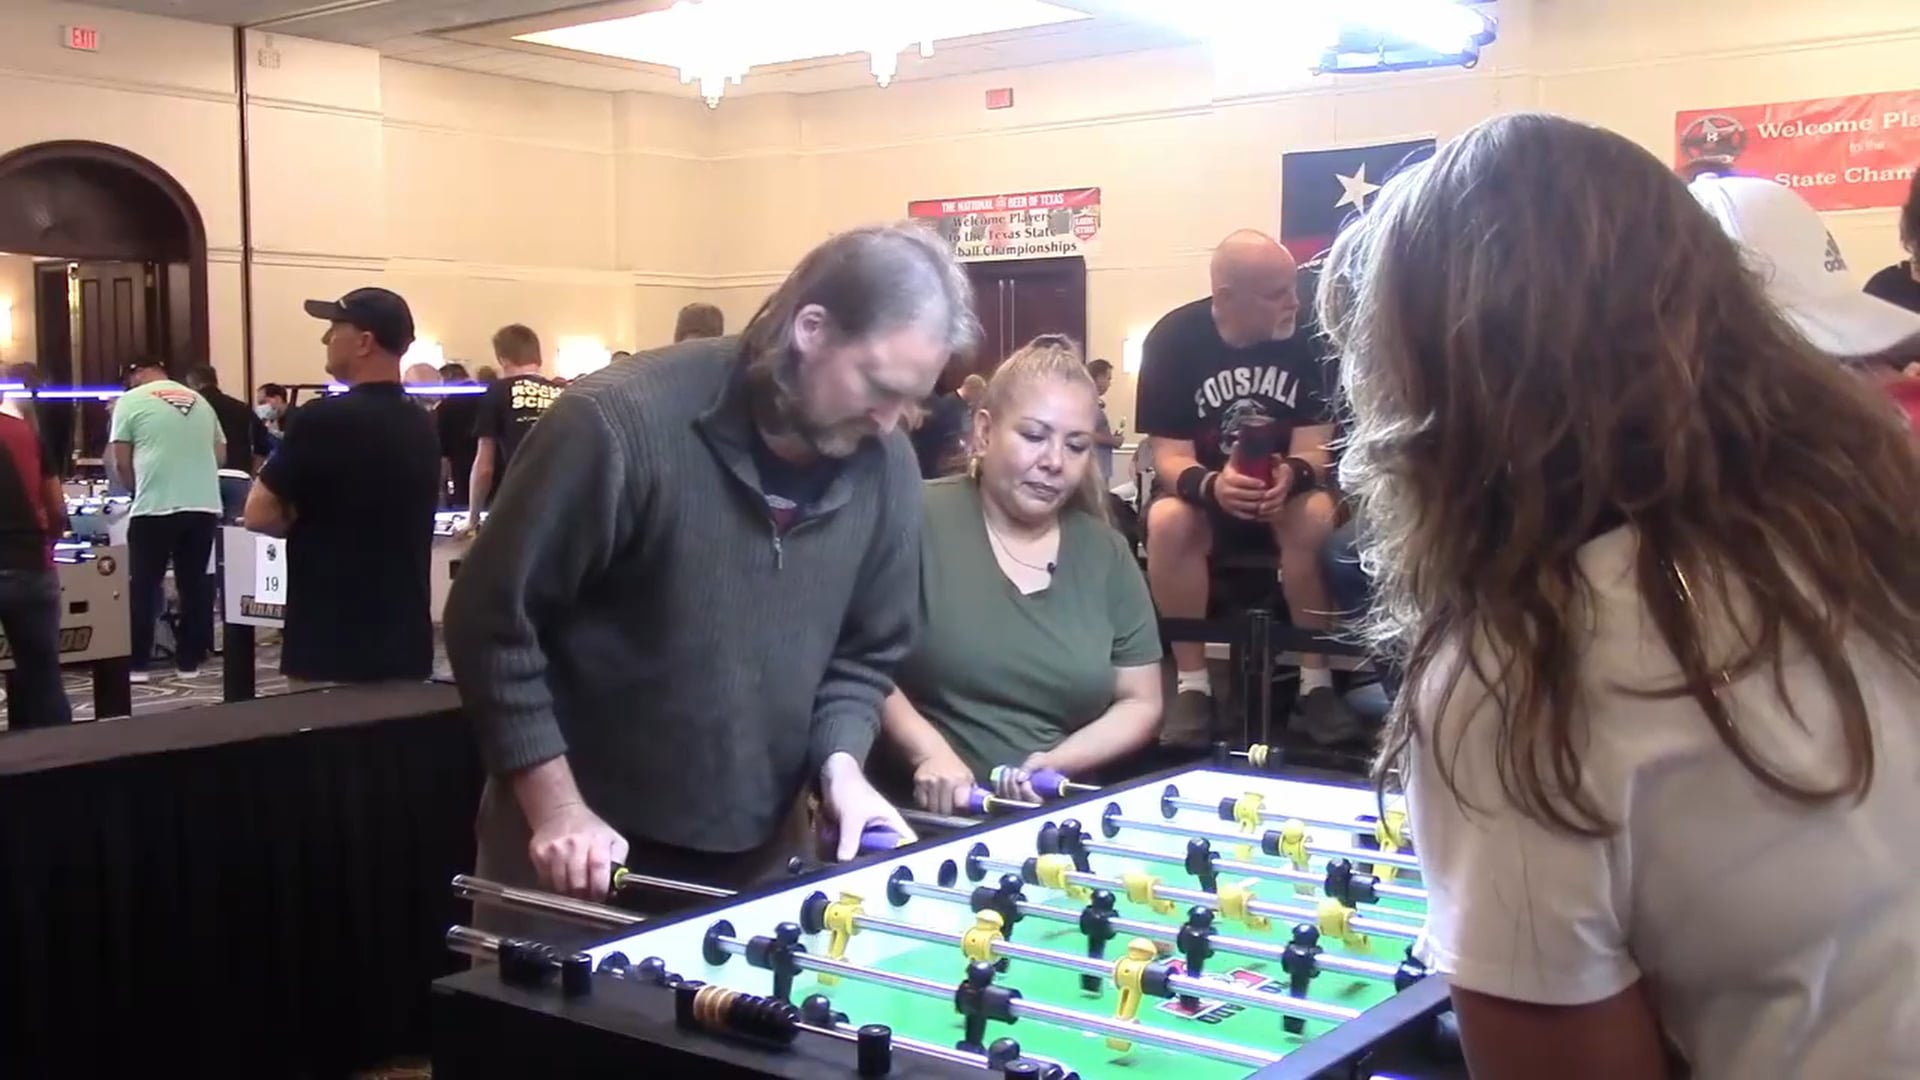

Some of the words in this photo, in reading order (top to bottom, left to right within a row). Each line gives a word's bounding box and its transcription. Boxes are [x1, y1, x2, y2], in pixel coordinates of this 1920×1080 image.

[72, 27, 97, 49] EXIT
[1757, 118, 1873, 139] Welcome
[1775, 171, 1836, 188] State
[942, 202, 956, 213] THE
[958, 200, 993, 212] NATIONAL
[1039, 193, 1064, 205] TEXAS
[953, 214, 1005, 228] Welcome
[1009, 212, 1053, 227] Players
[965, 231, 983, 242] the
[988, 229, 1021, 241] Texas
[1024, 227, 1057, 239] State
[957, 246, 980, 258] ball
[983, 240, 1077, 257] Championships
[264, 576, 280, 592] 19
